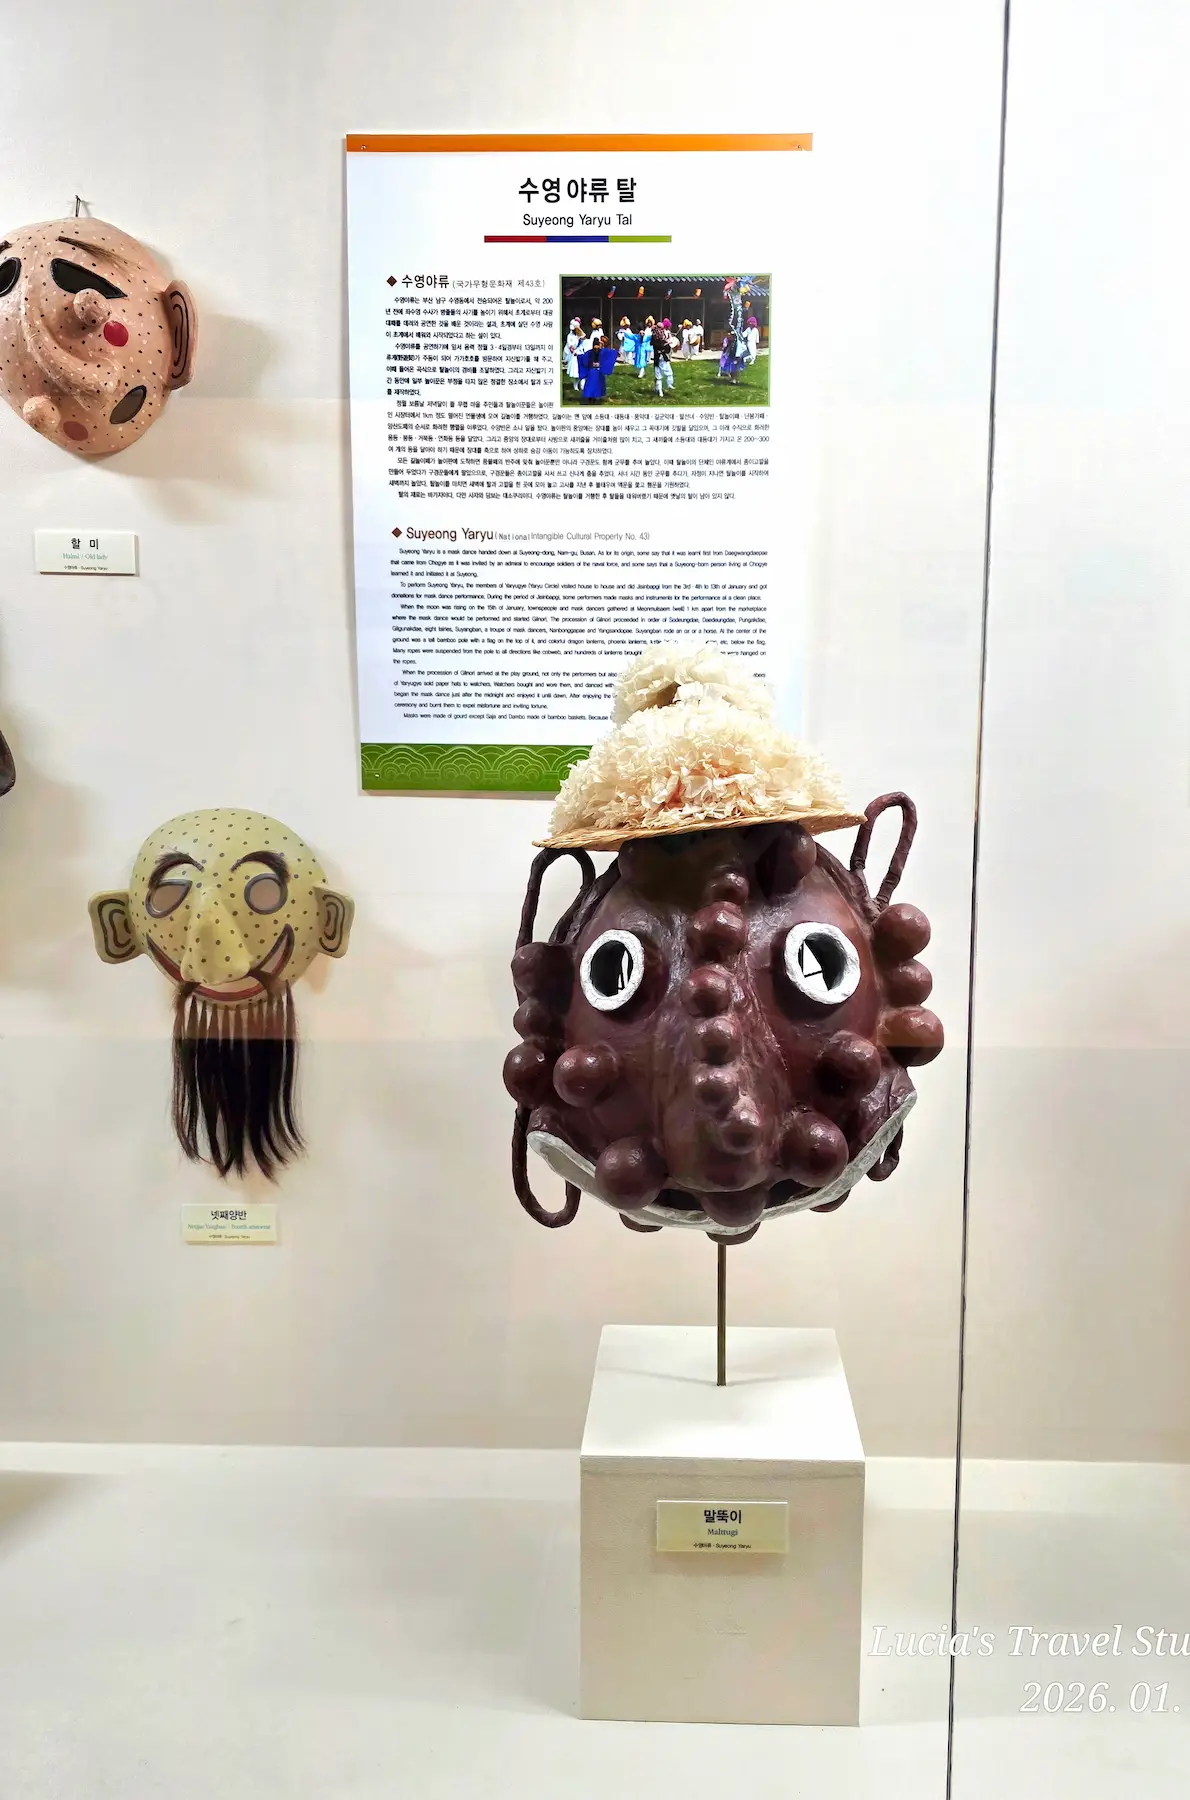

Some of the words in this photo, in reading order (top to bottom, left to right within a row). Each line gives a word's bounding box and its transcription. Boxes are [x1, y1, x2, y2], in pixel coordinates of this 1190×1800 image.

[518, 178, 560, 203] 수영
[567, 178, 609, 203] 야류
[617, 177, 637, 202] 탈
[523, 214, 574, 228] Suyeong
[579, 214, 611, 228] Yaryu
[616, 214, 632, 225] Tal
[401, 274, 449, 288] 수영야류
[406, 527, 457, 542] Suyeong
[461, 527, 494, 542] Yaryu
[566, 532, 592, 540] Cultural
[594, 532, 623, 541] Property
[639, 532, 650, 540] 43)
[456, 570, 477, 578] Suyeong.
[211, 1210, 247, 1220] 넷째양반
[704, 1510, 741, 1524] 말뚝이
[708, 1528, 738, 1537] Malttugi
